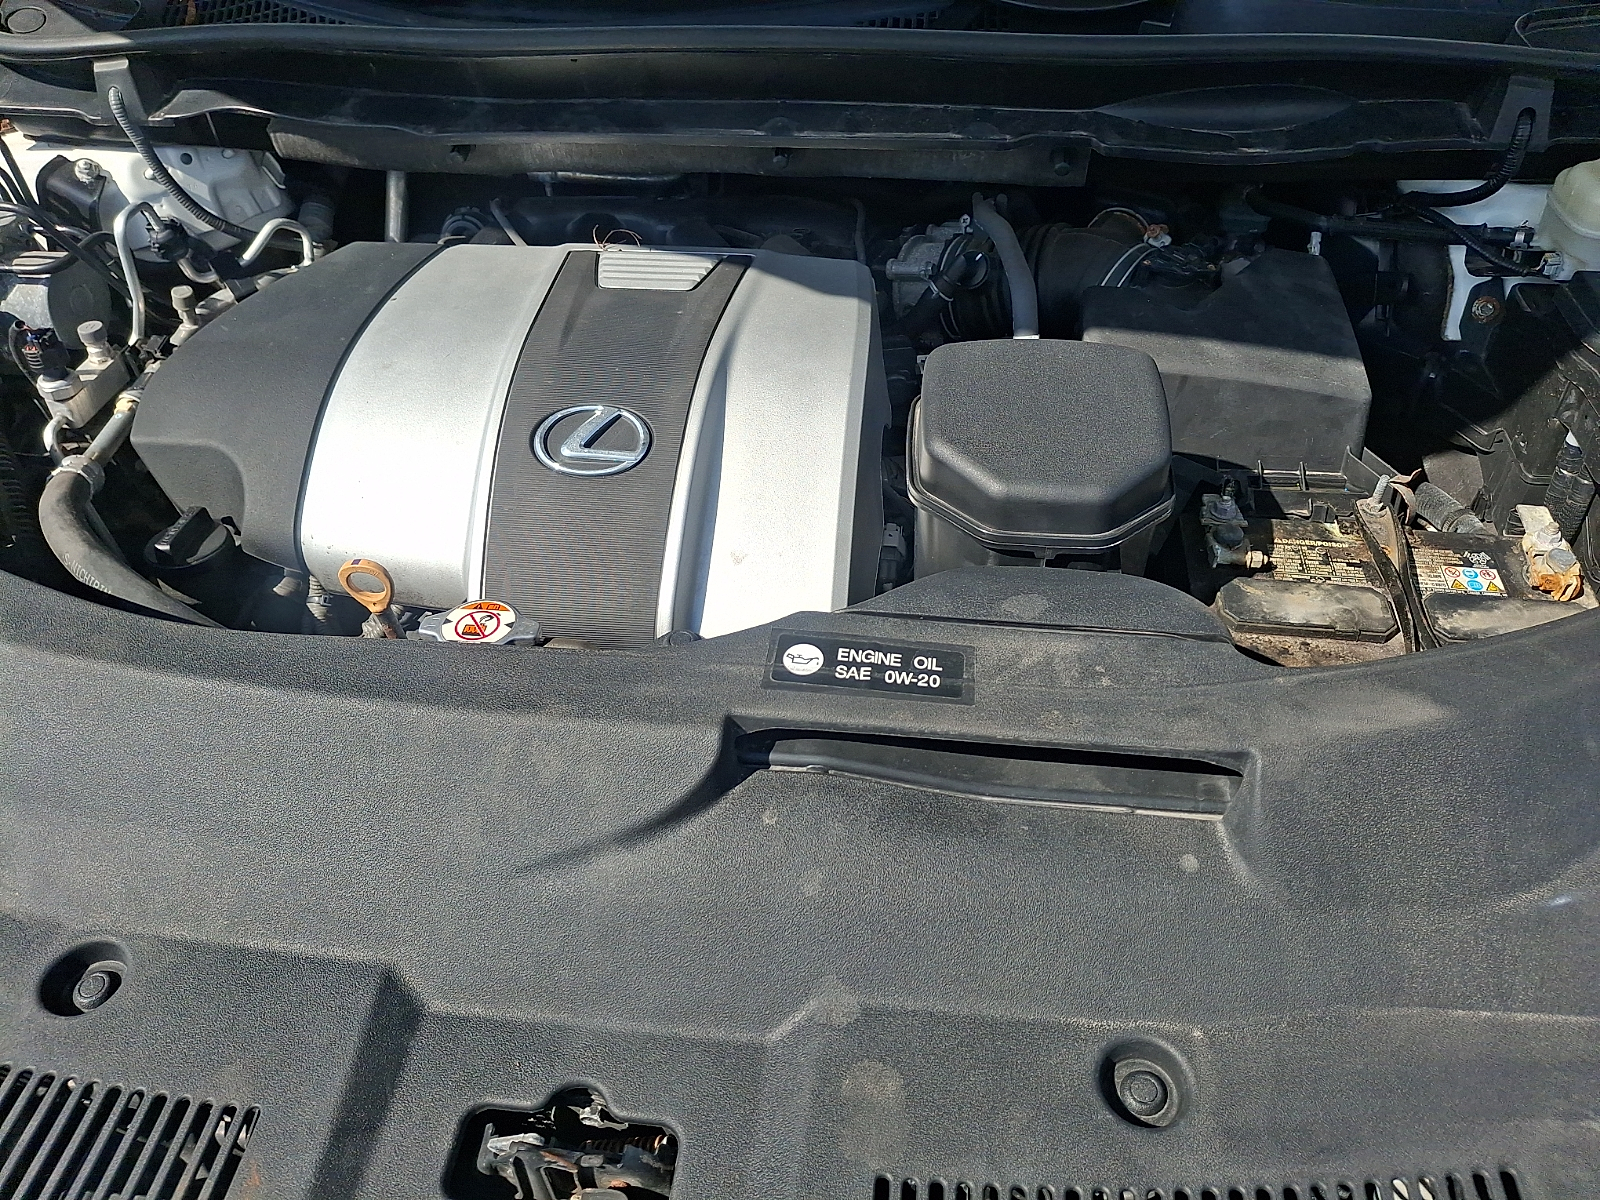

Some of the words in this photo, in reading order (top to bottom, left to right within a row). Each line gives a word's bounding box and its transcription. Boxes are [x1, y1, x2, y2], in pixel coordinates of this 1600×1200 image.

[1281, 538, 1349, 549] DANGER/POISON
[837, 647, 902, 667] ENGINE
[913, 656, 943, 671] OIL
[834, 665, 871, 681] SAE
[884, 670, 941, 688] 0W-20
